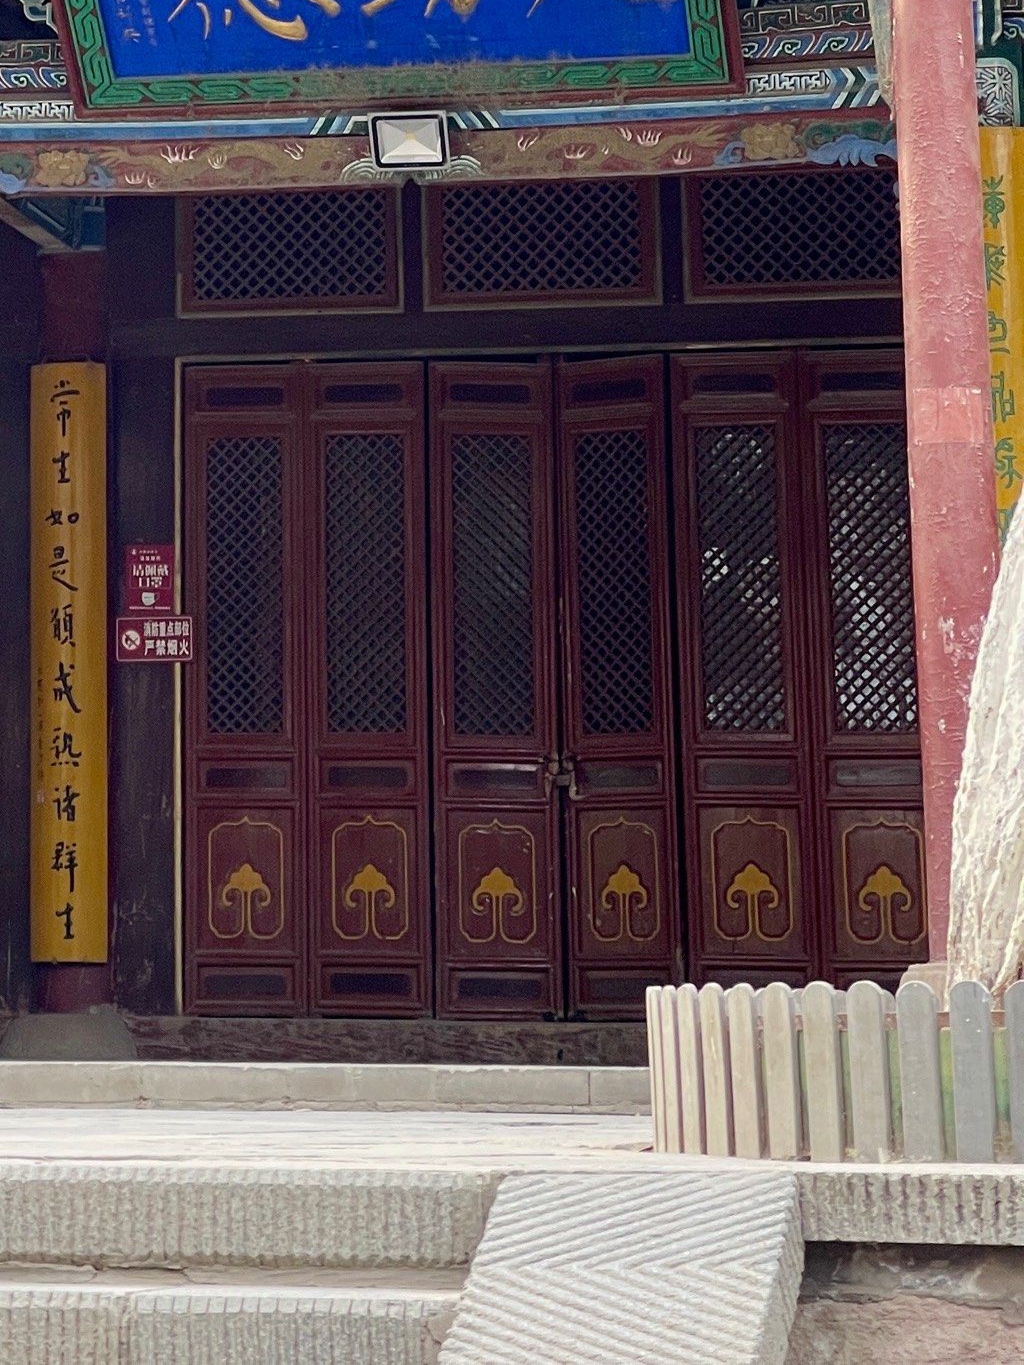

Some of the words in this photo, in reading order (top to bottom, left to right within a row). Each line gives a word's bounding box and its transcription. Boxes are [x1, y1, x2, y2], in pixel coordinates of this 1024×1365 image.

[143, 621, 189, 637] 消防重点部位
[144, 639, 189, 655] 严禁烟火
